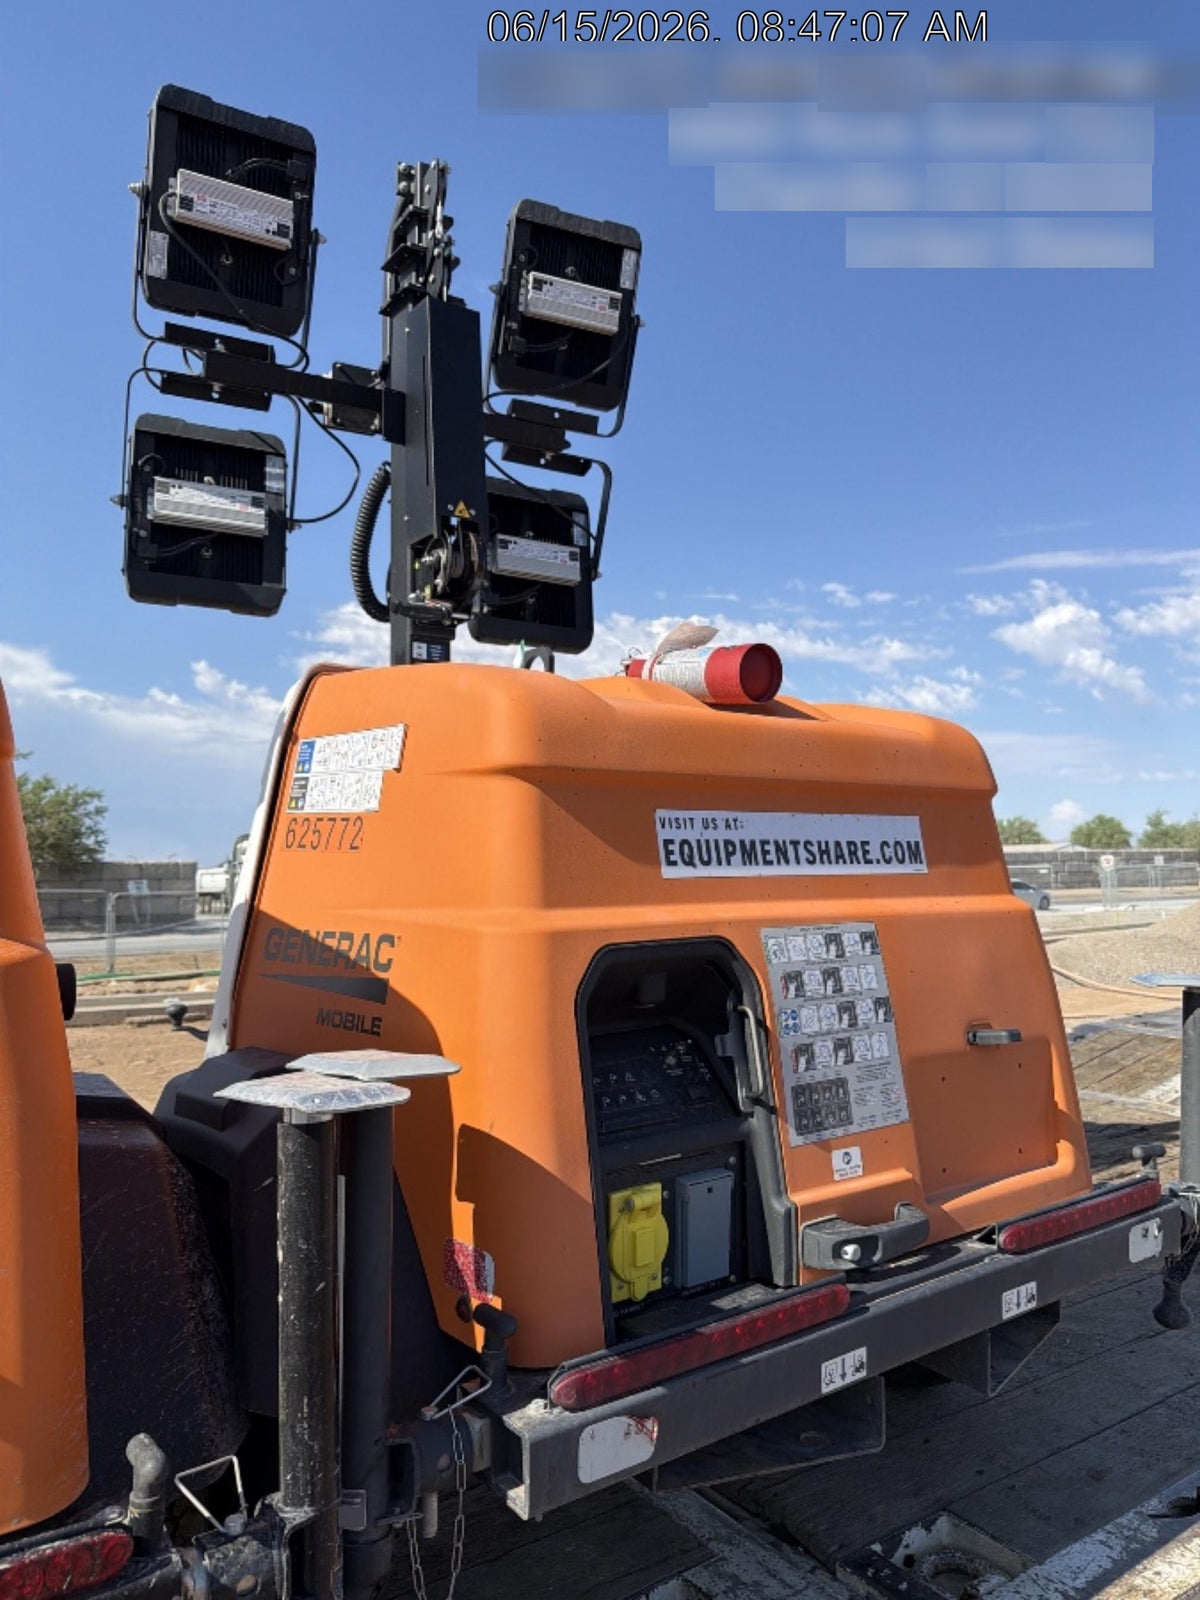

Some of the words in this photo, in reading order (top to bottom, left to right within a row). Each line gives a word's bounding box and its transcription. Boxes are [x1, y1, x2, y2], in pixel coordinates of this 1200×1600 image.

[286, 816, 363, 850] 625772
[659, 817, 694, 830] VISIT
[702, 817, 718, 830] US
[722, 816, 744, 830] AT:
[662, 838, 924, 868] EQUIPMENTSHARE.COM
[264, 927, 396, 973] GENERAC
[315, 1008, 383, 1037] MOBILE
